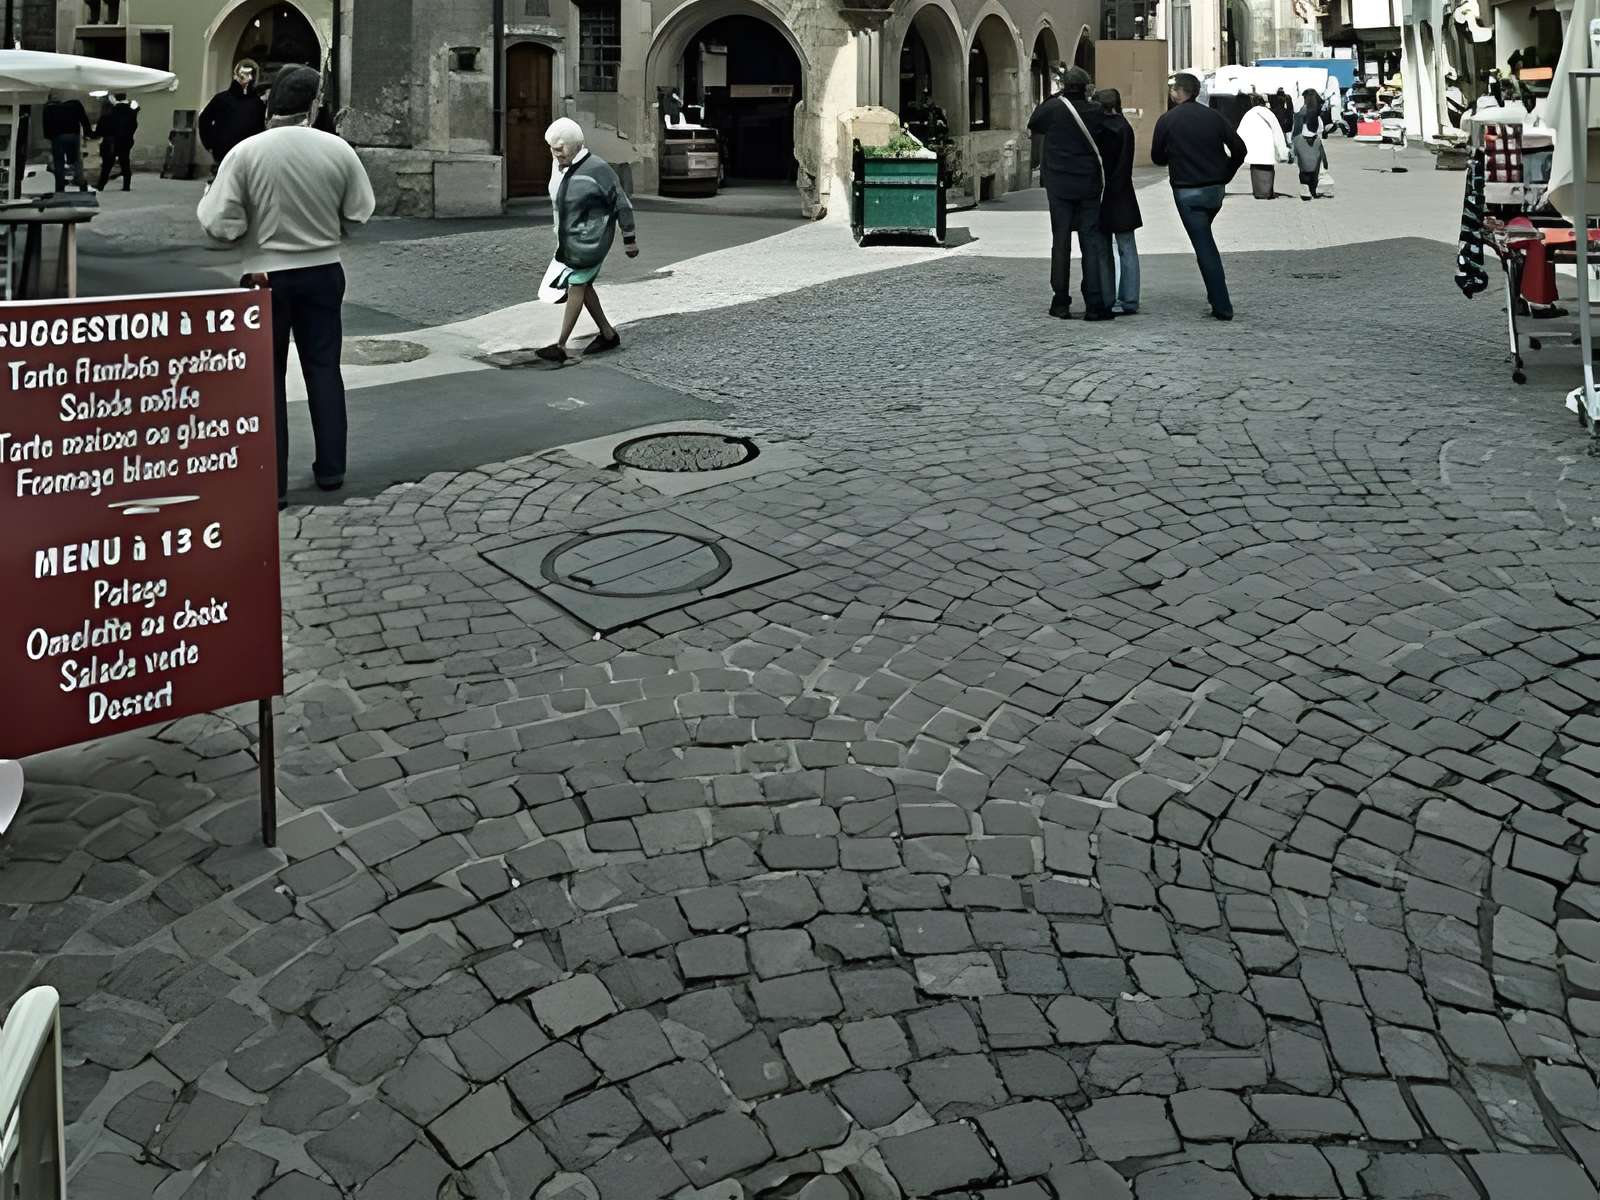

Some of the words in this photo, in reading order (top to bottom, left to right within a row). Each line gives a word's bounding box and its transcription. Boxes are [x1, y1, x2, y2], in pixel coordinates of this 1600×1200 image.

[206, 309, 235, 333] 12
[243, 305, 260, 329] €
[35, 537, 120, 578] MENU
[161, 528, 192, 556] 13
[203, 522, 222, 548] €
[145, 640, 199, 673] verte
